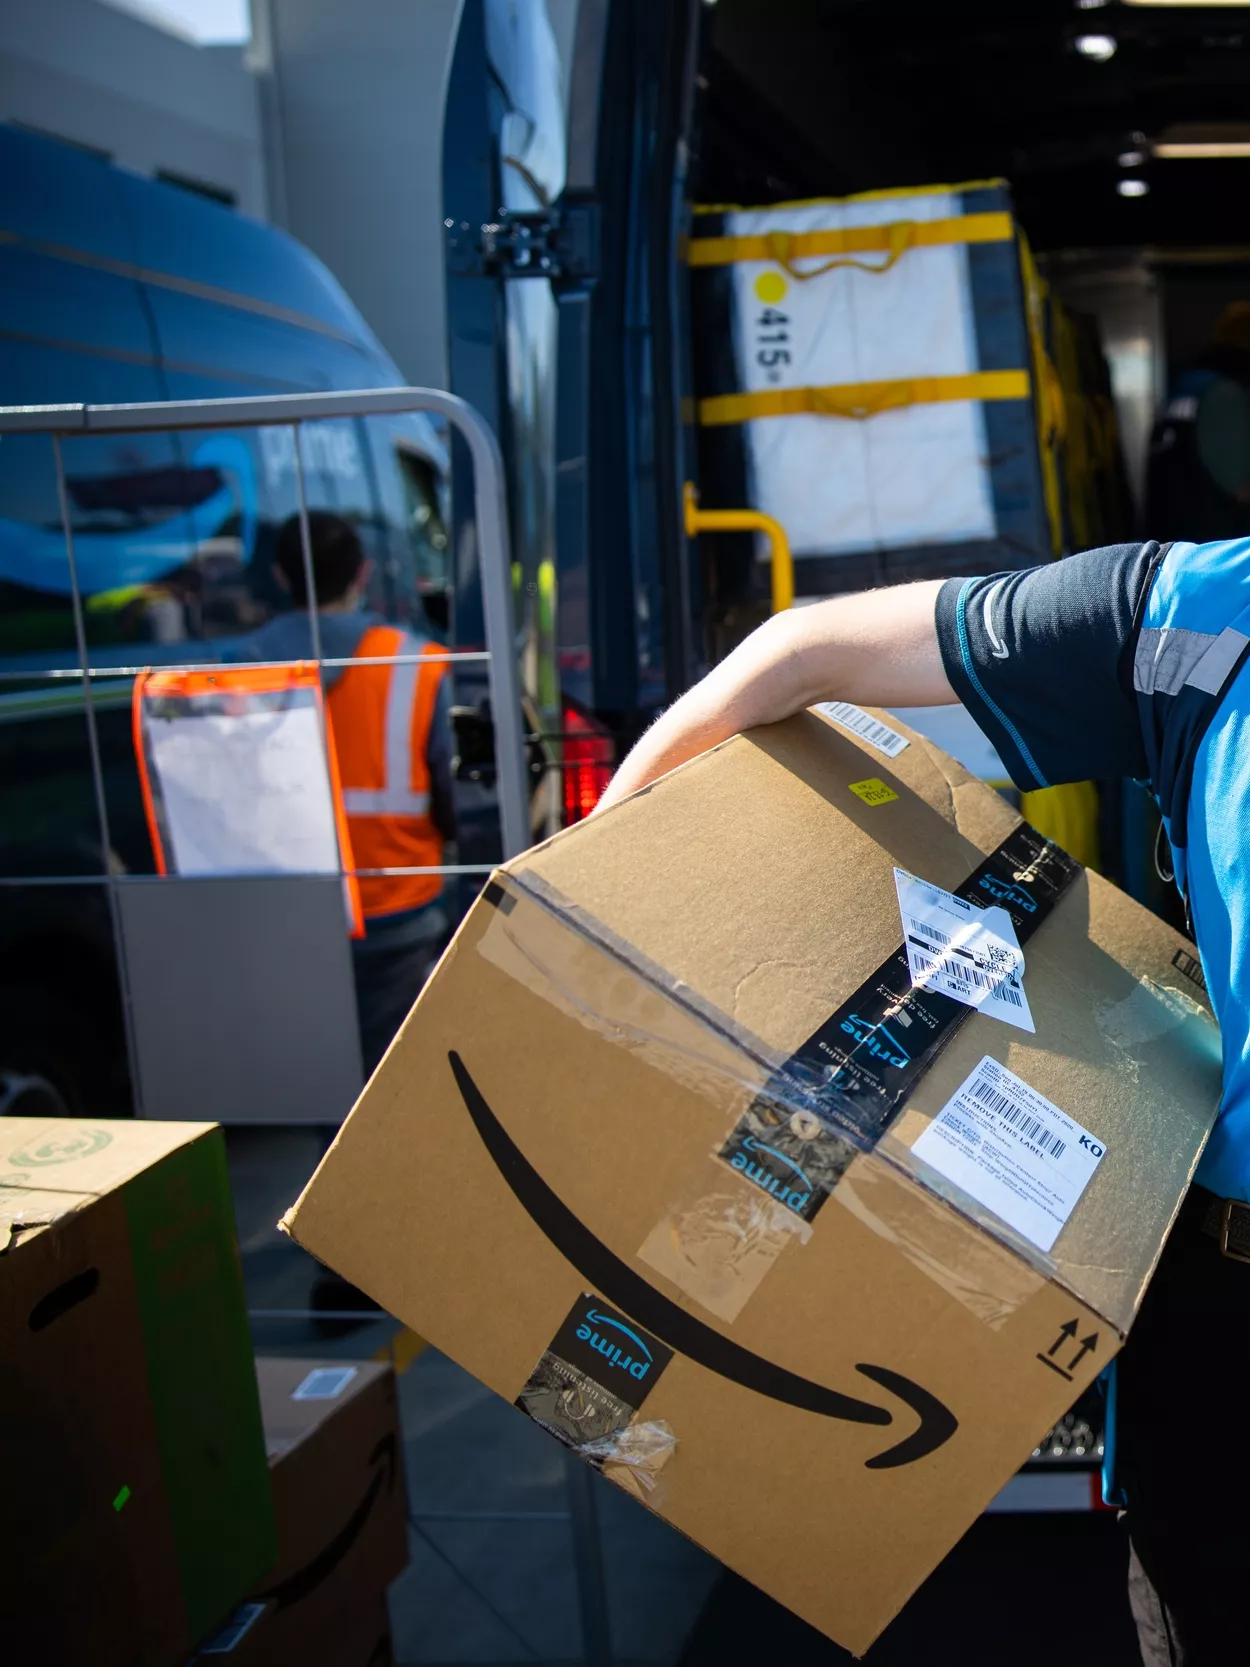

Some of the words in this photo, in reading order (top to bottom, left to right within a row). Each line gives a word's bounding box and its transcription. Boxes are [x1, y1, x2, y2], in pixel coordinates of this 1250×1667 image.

[757, 308, 791, 368] 415
[916, 1010, 936, 1029] free
[818, 1043, 861, 1078] listning
[838, 1018, 908, 1070] prime
[862, 1075, 886, 1094] free
[830, 1110, 860, 1133] video
[959, 1092, 996, 1122] REMOVE
[997, 1120, 1018, 1138] THIS
[1018, 1136, 1046, 1159] LABEL
[1077, 1134, 1104, 1159] KO
[730, 1150, 809, 1213] prime
[575, 1322, 648, 1379] prime
[551, 1362, 598, 1399] listening
[599, 1396, 622, 1416] free
